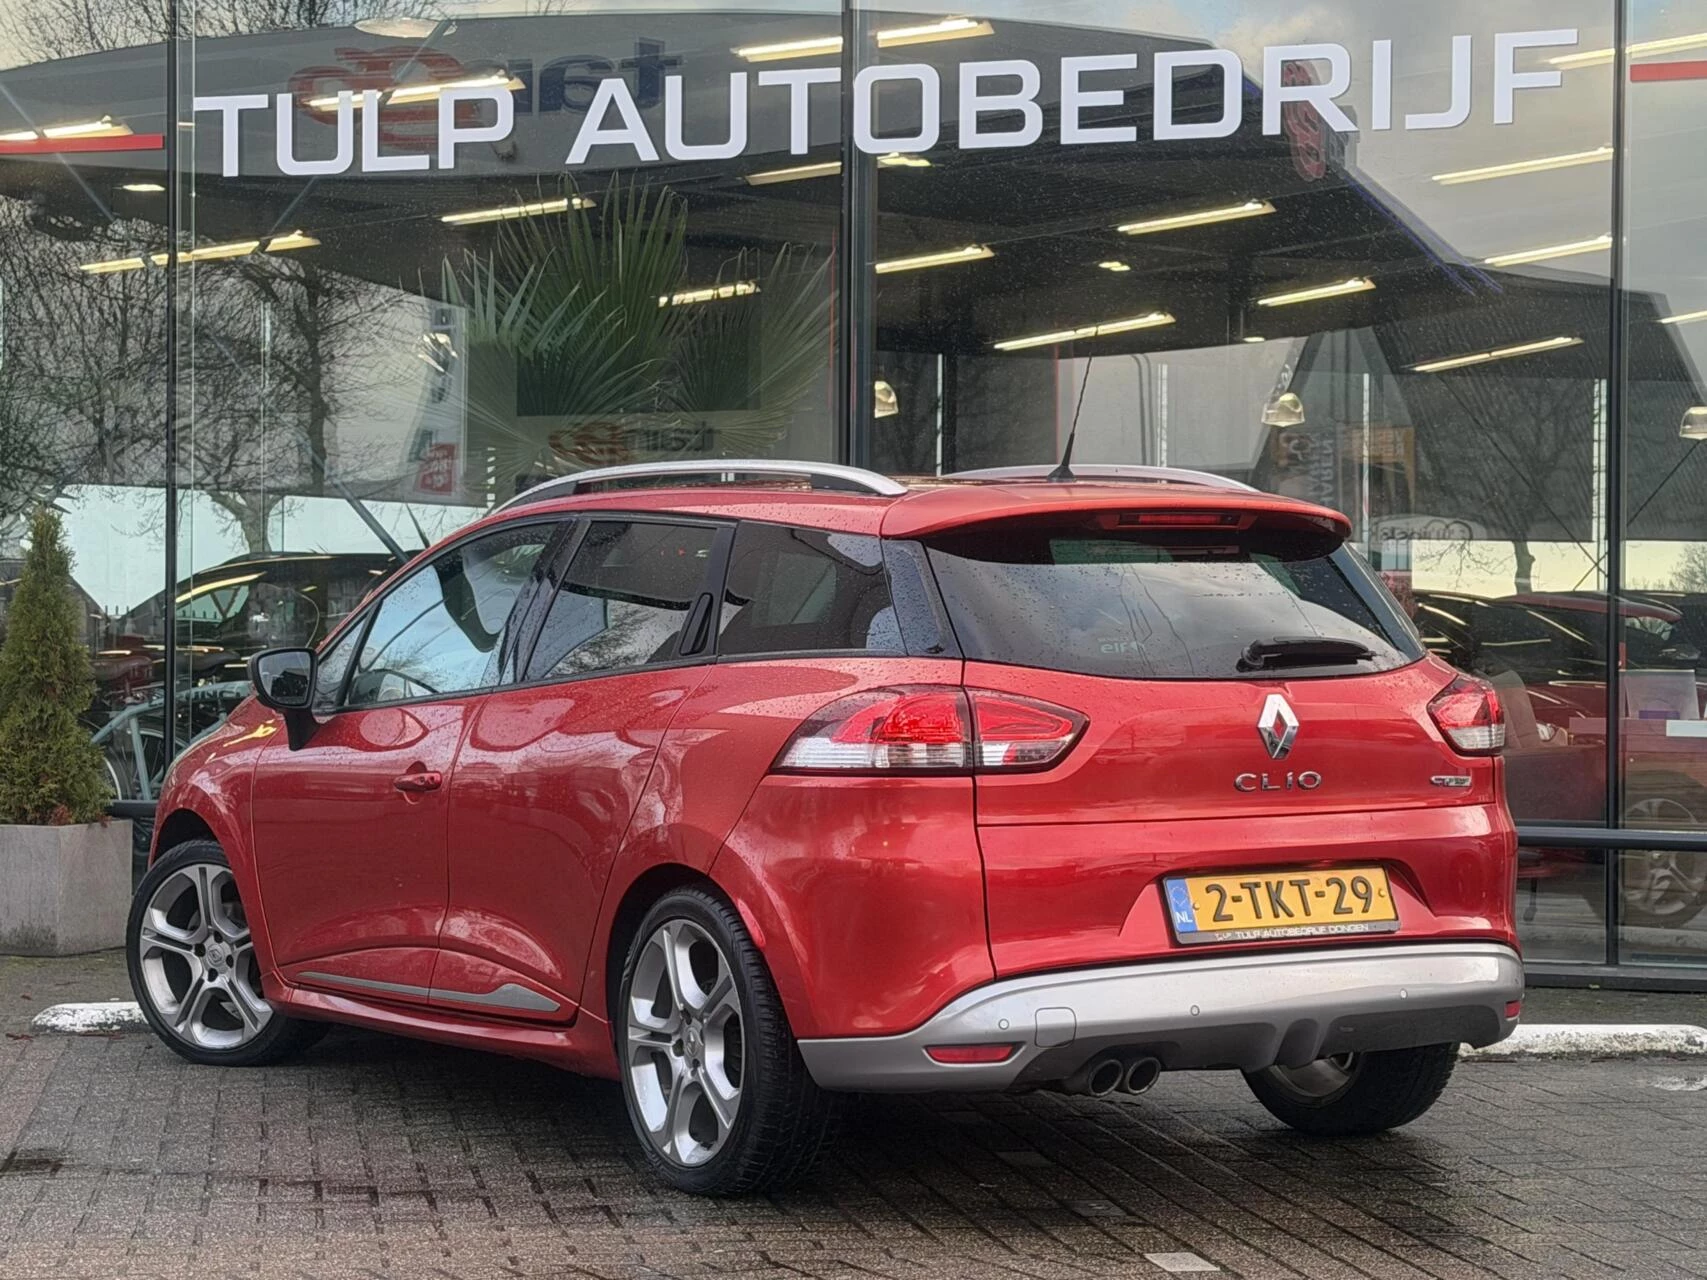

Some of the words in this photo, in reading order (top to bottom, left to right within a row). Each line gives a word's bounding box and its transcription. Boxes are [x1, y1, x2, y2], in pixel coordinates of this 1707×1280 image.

[194, 89, 514, 176] TULP
[565, 29, 1578, 164] AUTOBEDRIJF
[1234, 771, 1322, 792] CLIO
[1205, 876, 1373, 922] 2-TKT-29
[1175, 911, 1193, 924] NL
[1328, 923, 1369, 934] DONGEN
